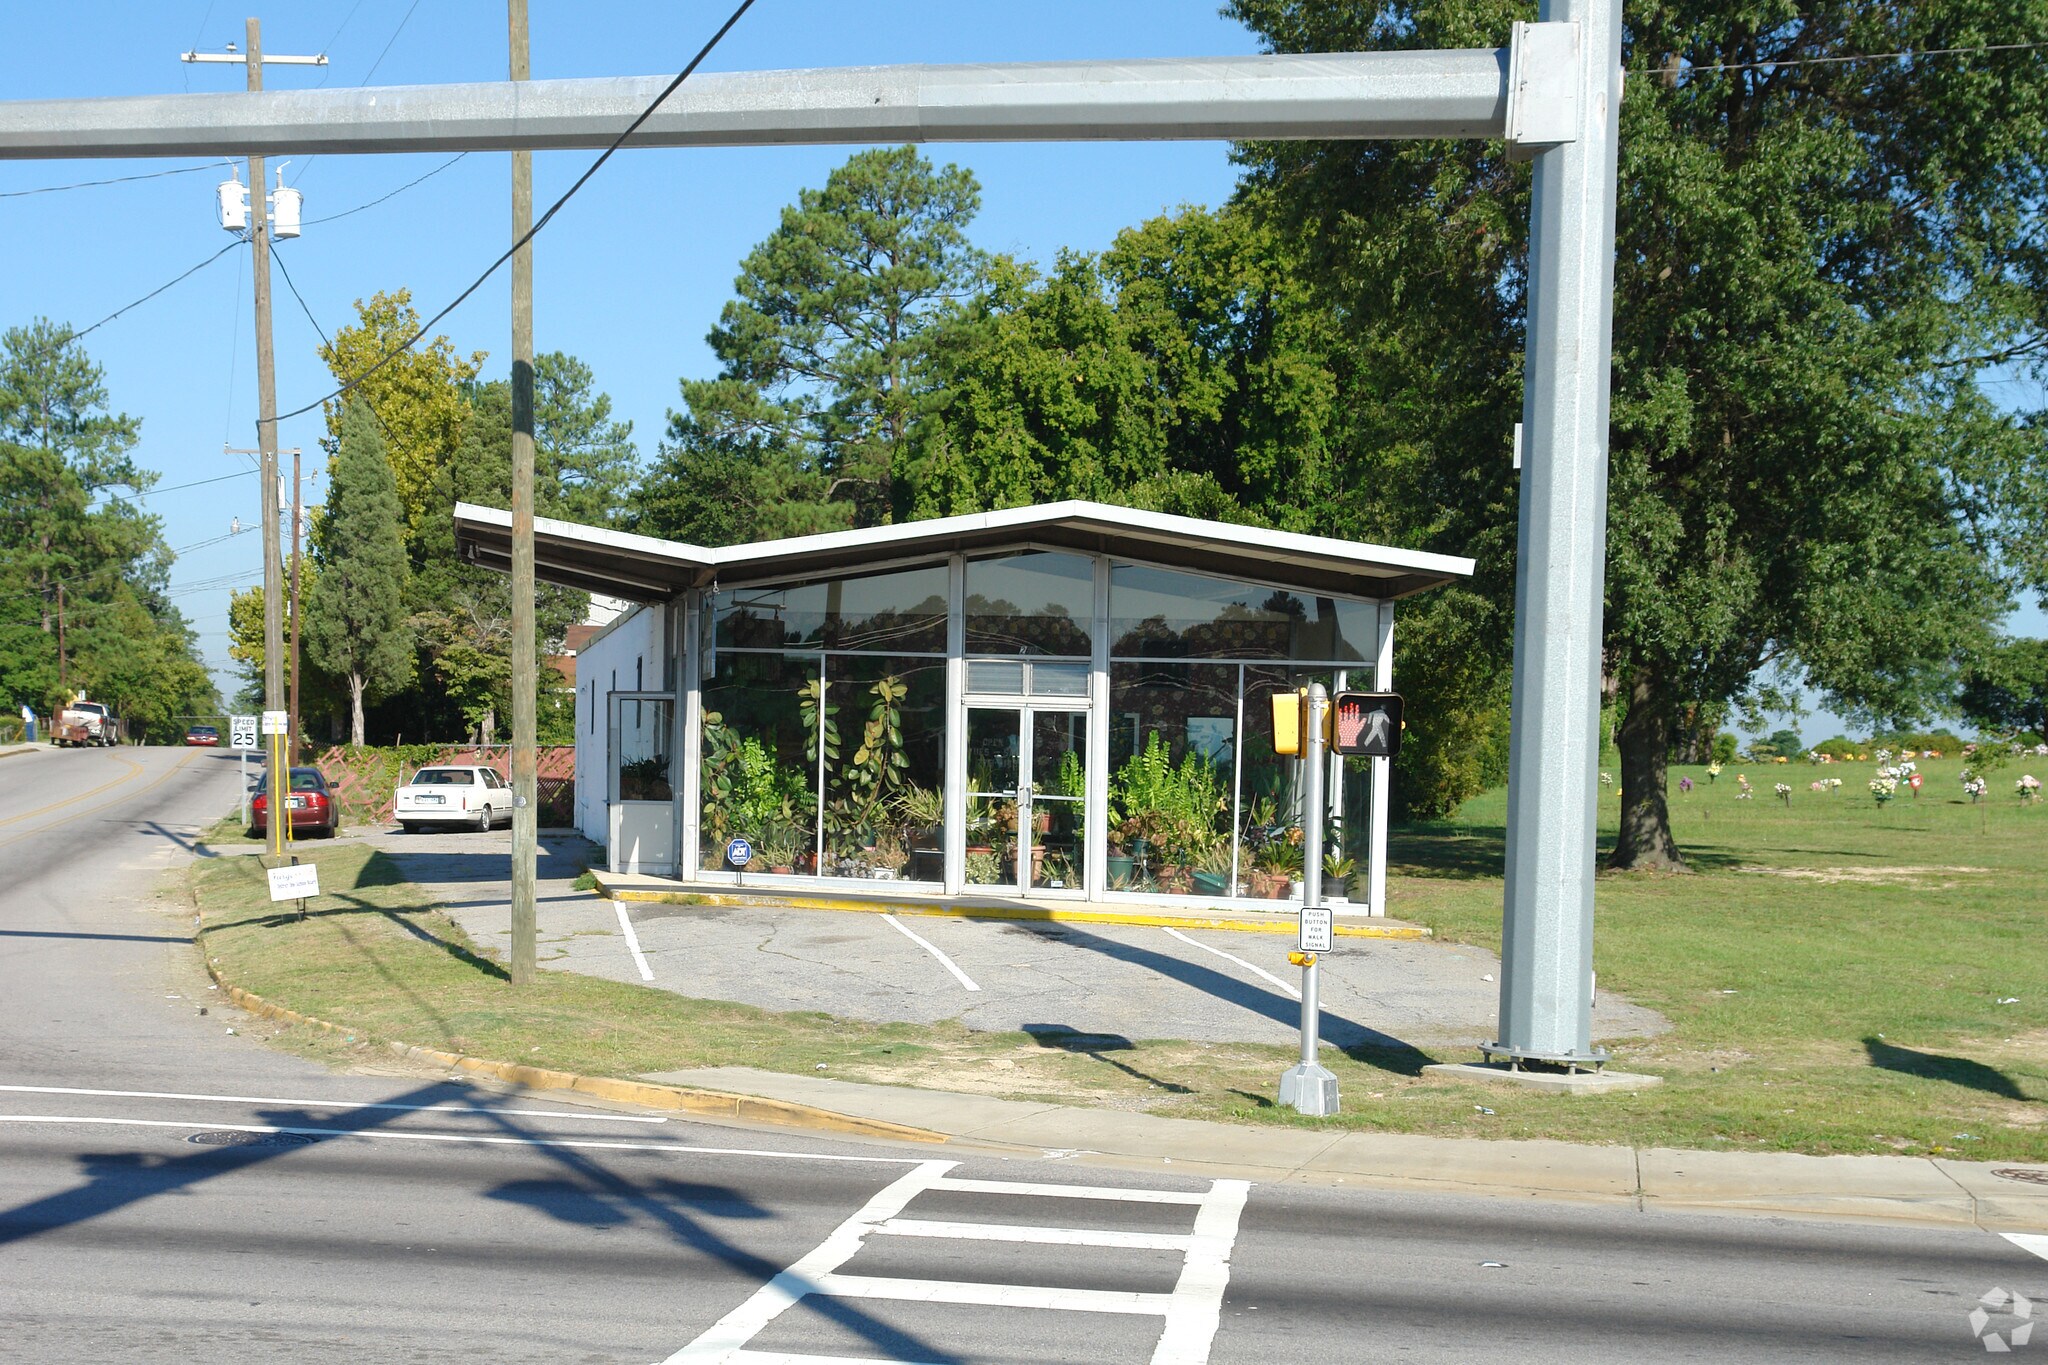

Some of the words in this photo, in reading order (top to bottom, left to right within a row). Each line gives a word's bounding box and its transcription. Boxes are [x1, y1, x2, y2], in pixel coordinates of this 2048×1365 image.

[233, 733, 255, 746] 25
[982, 737, 1004, 746] OPEN
[732, 847, 747, 856] ADT
